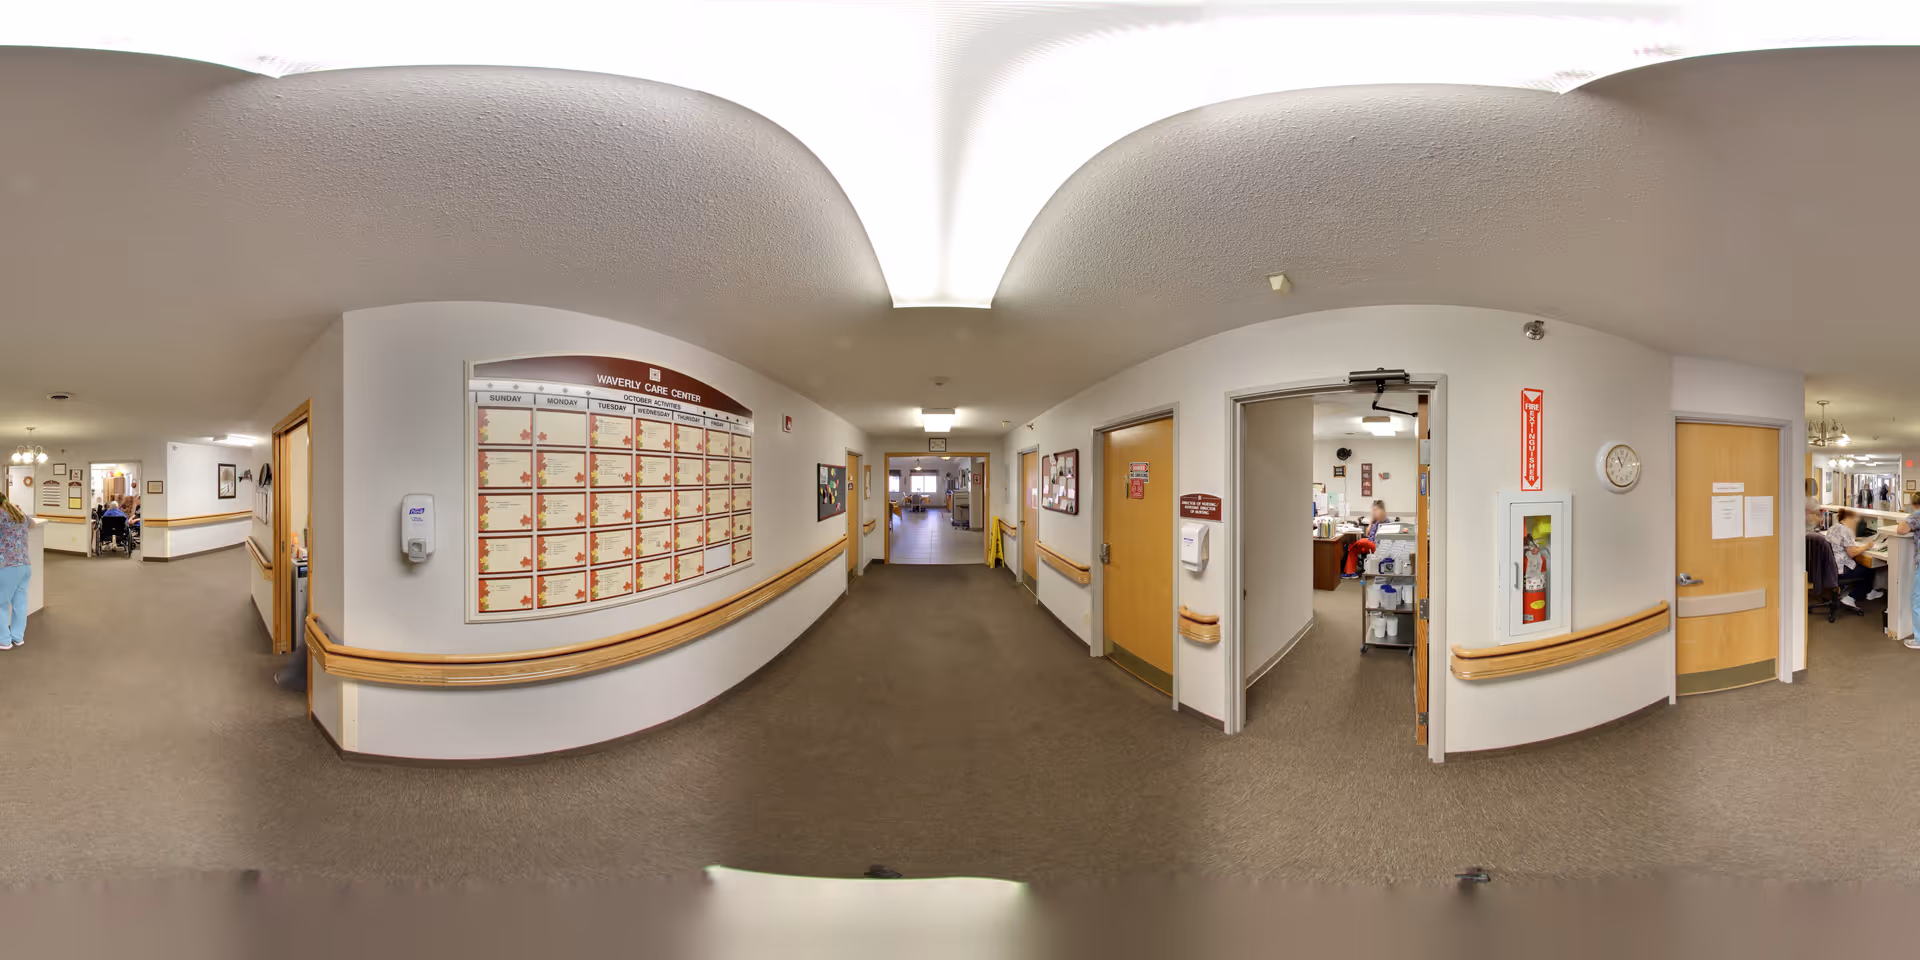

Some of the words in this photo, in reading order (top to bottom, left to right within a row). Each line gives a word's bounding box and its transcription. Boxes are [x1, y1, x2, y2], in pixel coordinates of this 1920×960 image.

[596, 374, 641, 390] WAVERLY
[644, 383, 668, 396] CARE
[671, 388, 701, 403] CENTER
[598, 402, 626, 411] TUESDAY
[624, 394, 652, 404] OCTOBER
[654, 400, 681, 410] ACTIVITIES
[638, 408, 670, 418] WEDNESDAY
[677, 414, 700, 422] THURSDAY
